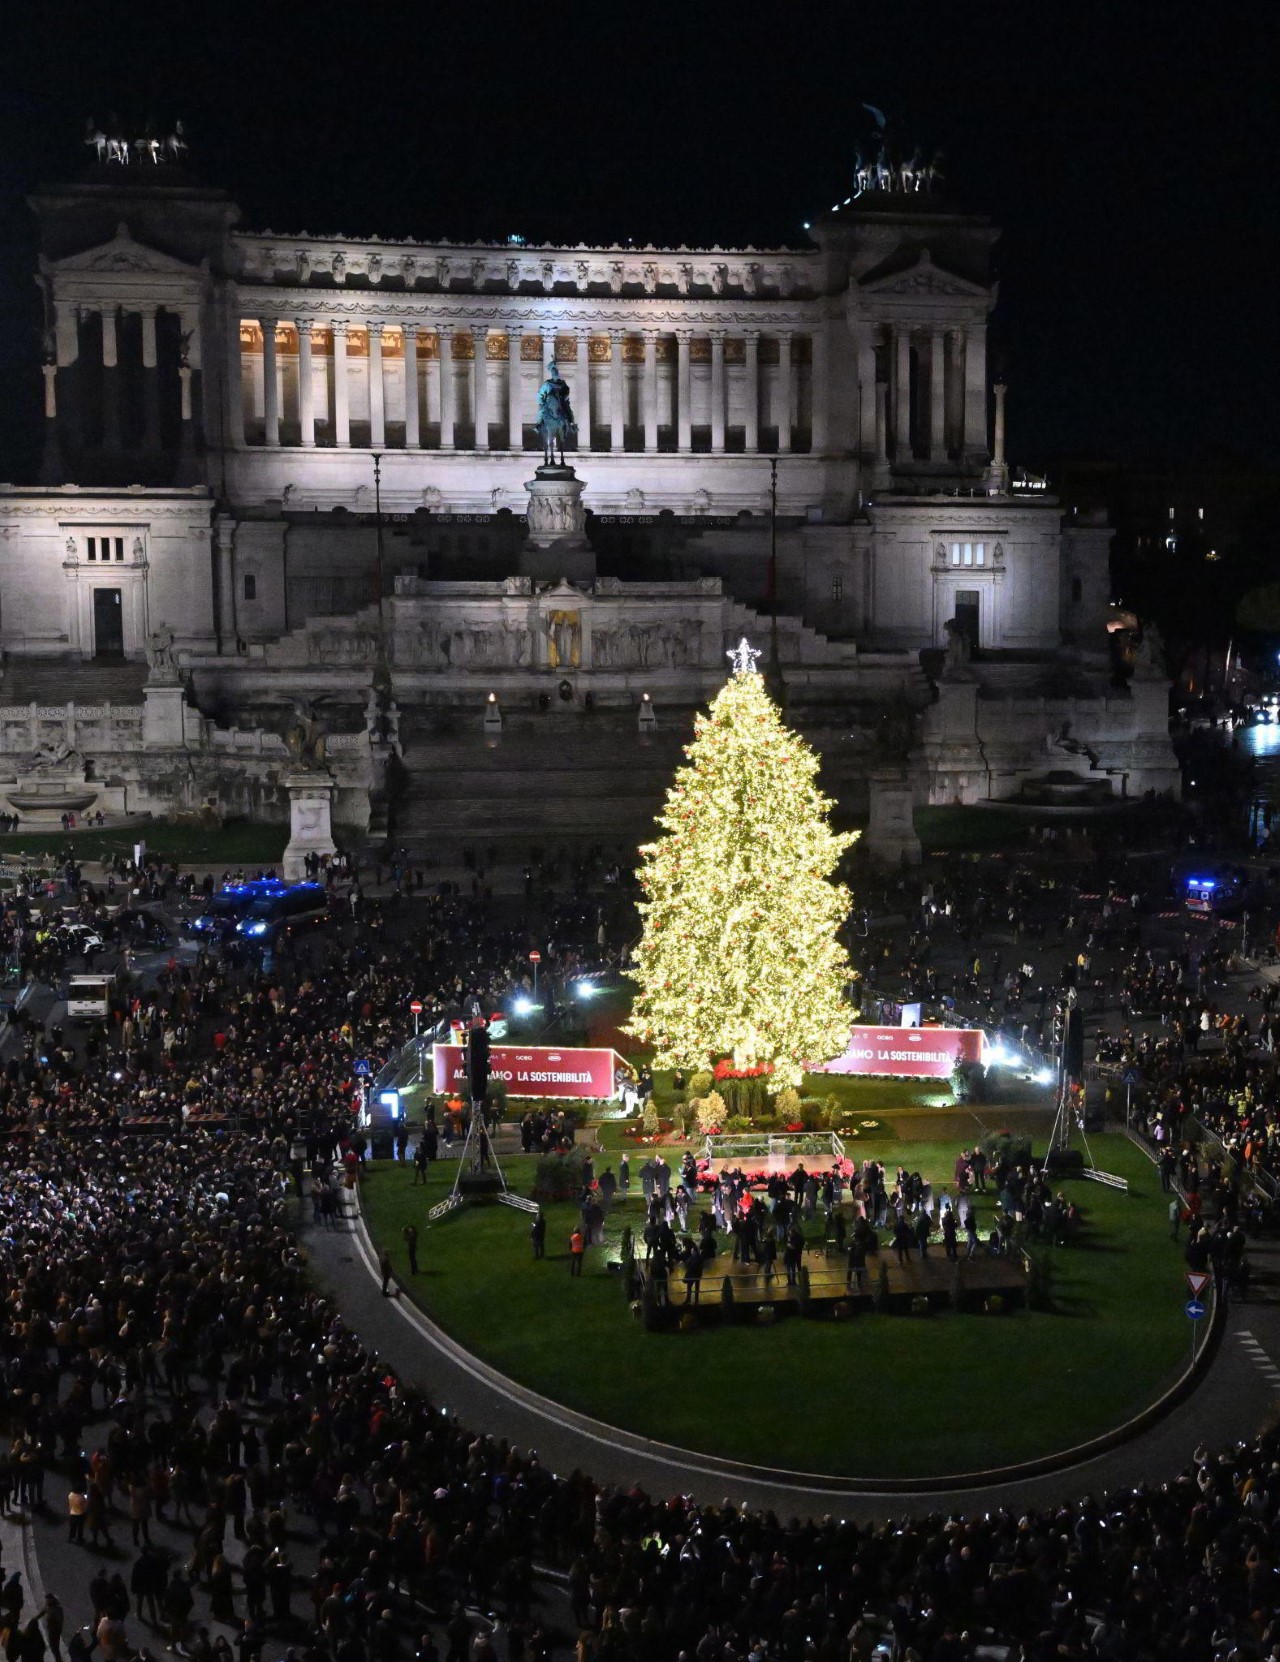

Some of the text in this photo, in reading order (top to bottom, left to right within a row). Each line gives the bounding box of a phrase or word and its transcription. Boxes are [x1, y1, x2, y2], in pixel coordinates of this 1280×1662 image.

[878, 1050, 890, 1060] LA
[517, 1071, 529, 1082] LA
[530, 1071, 593, 1083] SOSTENIBILITÀ
